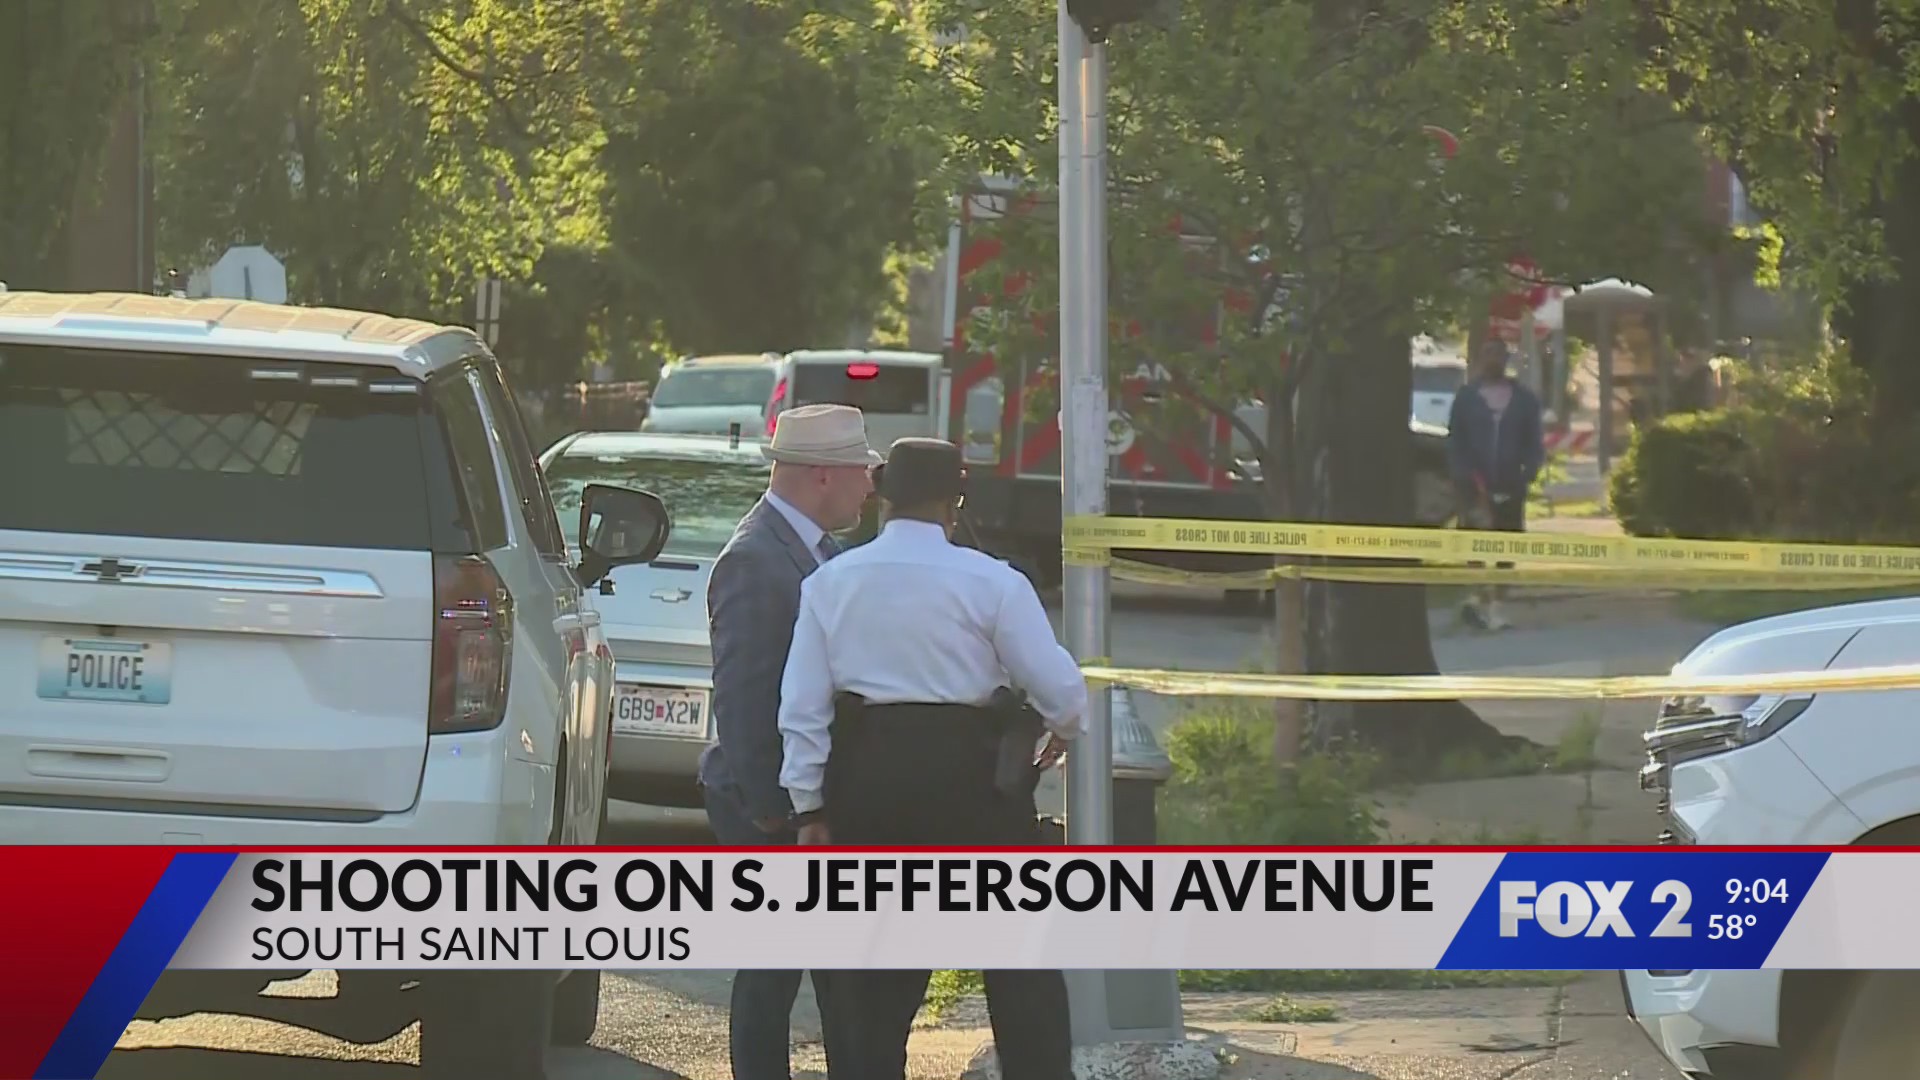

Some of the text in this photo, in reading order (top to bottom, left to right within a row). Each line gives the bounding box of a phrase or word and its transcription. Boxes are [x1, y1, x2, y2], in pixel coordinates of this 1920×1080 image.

[66, 653, 145, 690] POLICE
[619, 696, 701, 725] GB9 X2W
